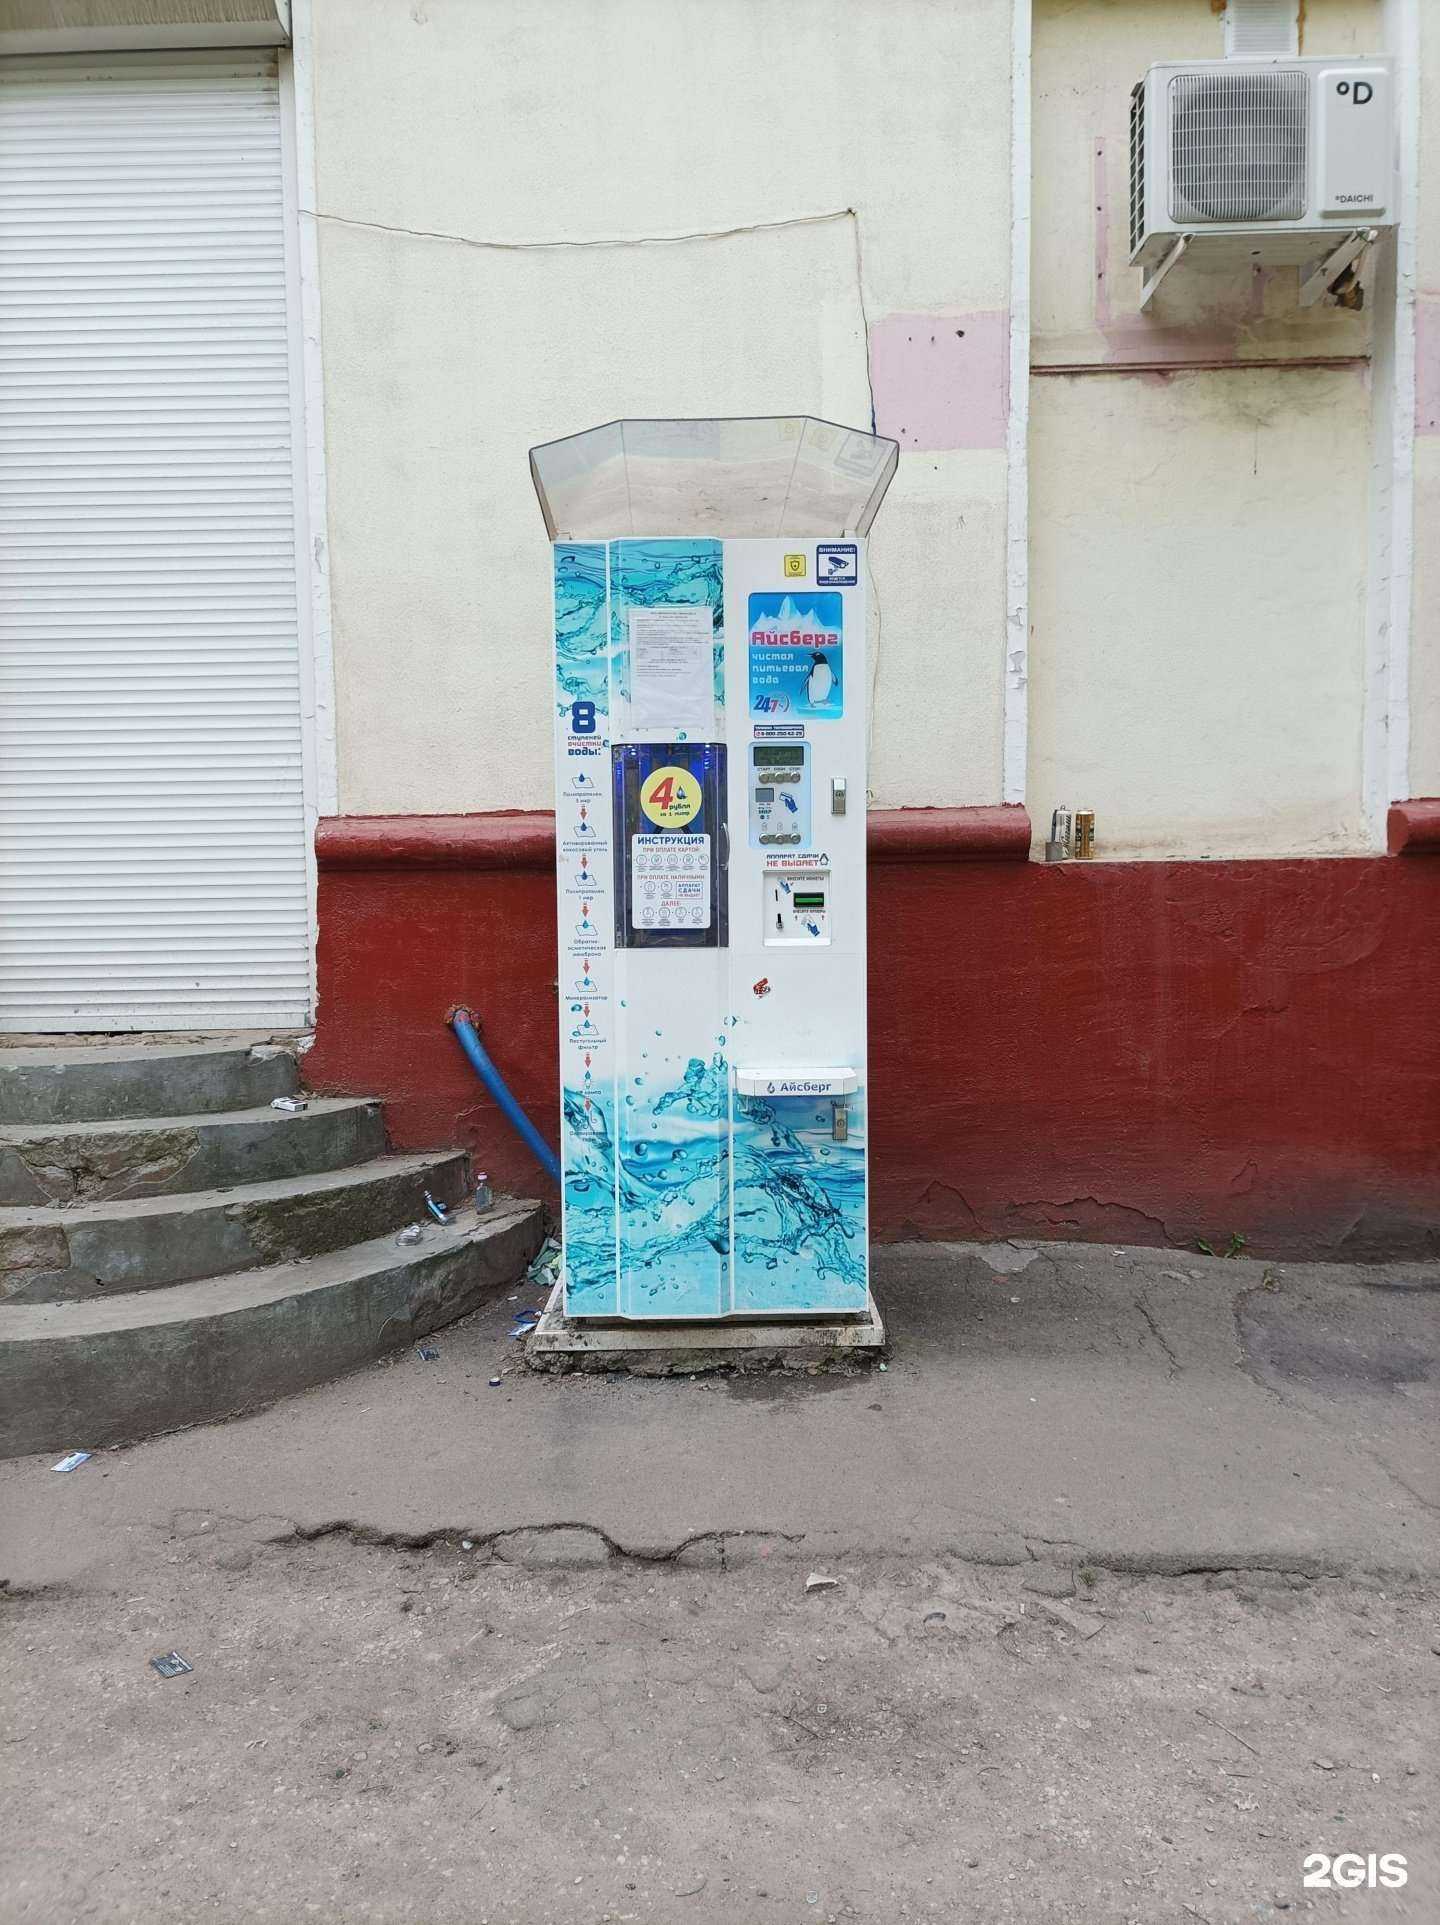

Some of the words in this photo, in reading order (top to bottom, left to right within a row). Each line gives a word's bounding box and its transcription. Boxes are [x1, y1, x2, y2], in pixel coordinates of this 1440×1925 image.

[751, 630, 838, 648] Айсберг
[752, 675, 779, 684] вода
[571, 701, 596, 734] 8
[567, 747, 601, 756] воды:
[648, 777, 674, 810] 4
[637, 836, 705, 845] ИНСТРУКЦИЯ
[780, 1082, 832, 1092] Айсберг
